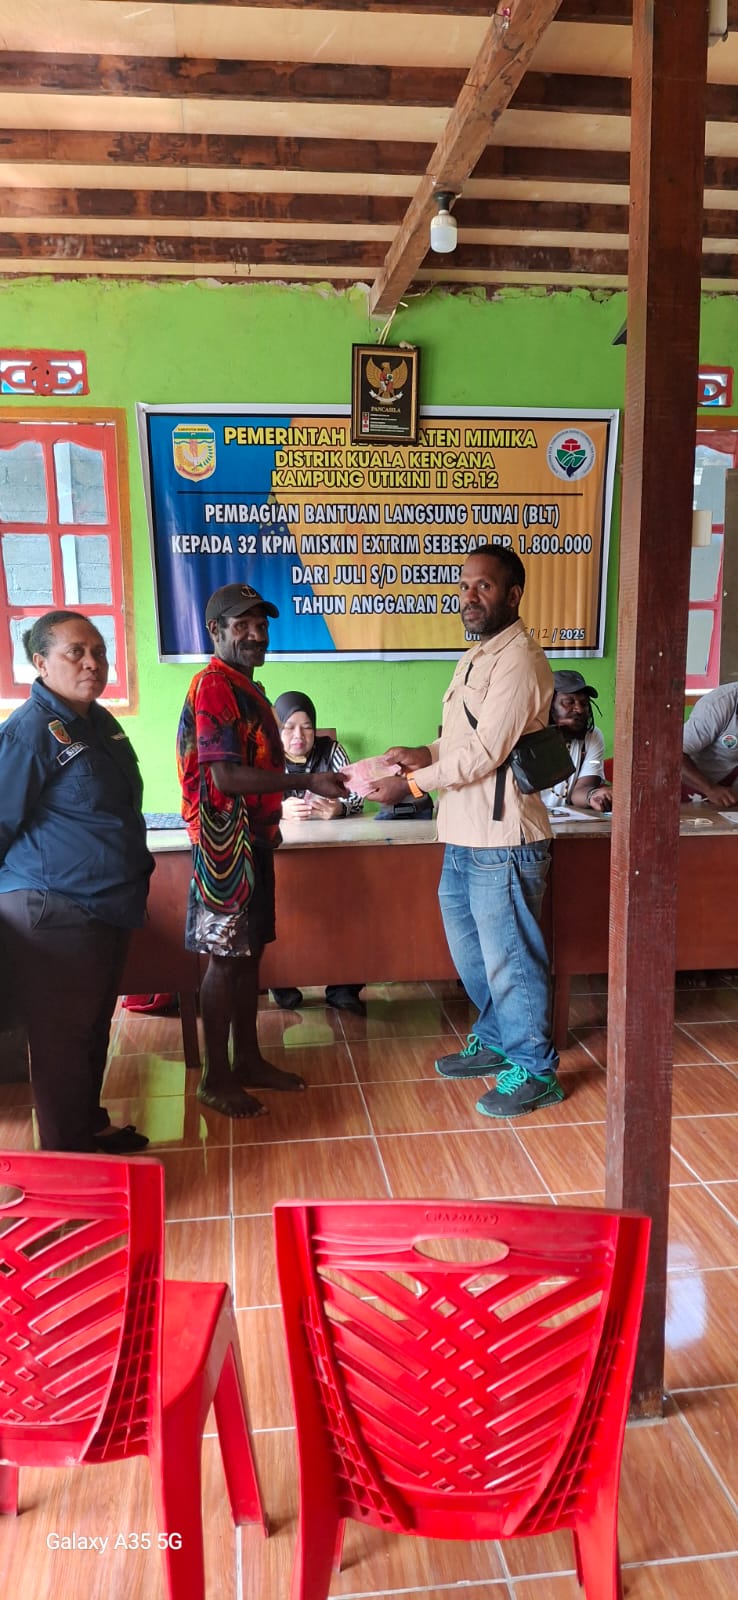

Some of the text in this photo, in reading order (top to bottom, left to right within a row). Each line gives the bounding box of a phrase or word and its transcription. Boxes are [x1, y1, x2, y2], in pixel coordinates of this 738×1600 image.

[224, 427, 345, 446] PEMERINTAH
[465, 429, 537, 448] MIMIKA
[275, 451, 495, 469] DISTRIK KUALA KENCANA
[272, 471, 498, 489] KAMPUNG UTIKINI II SP.12
[205, 504, 559, 528] PEMBAGIAN BANTUAN LANGSUNG TUNAI (BLT)
[172, 535, 232, 554] KEPADA
[238, 535, 257, 553] 32
[263, 535, 296, 553] KPM
[301, 535, 357, 554] MISKIN
[362, 535, 419, 554] EXTRIM
[519, 535, 592, 554] 1.800.000
[292, 565, 464, 588] DARI JULI S/D DESEMB
[293, 595, 460, 614] TAHUN ANGGARAN 20
[560, 629, 585, 640] 2025
